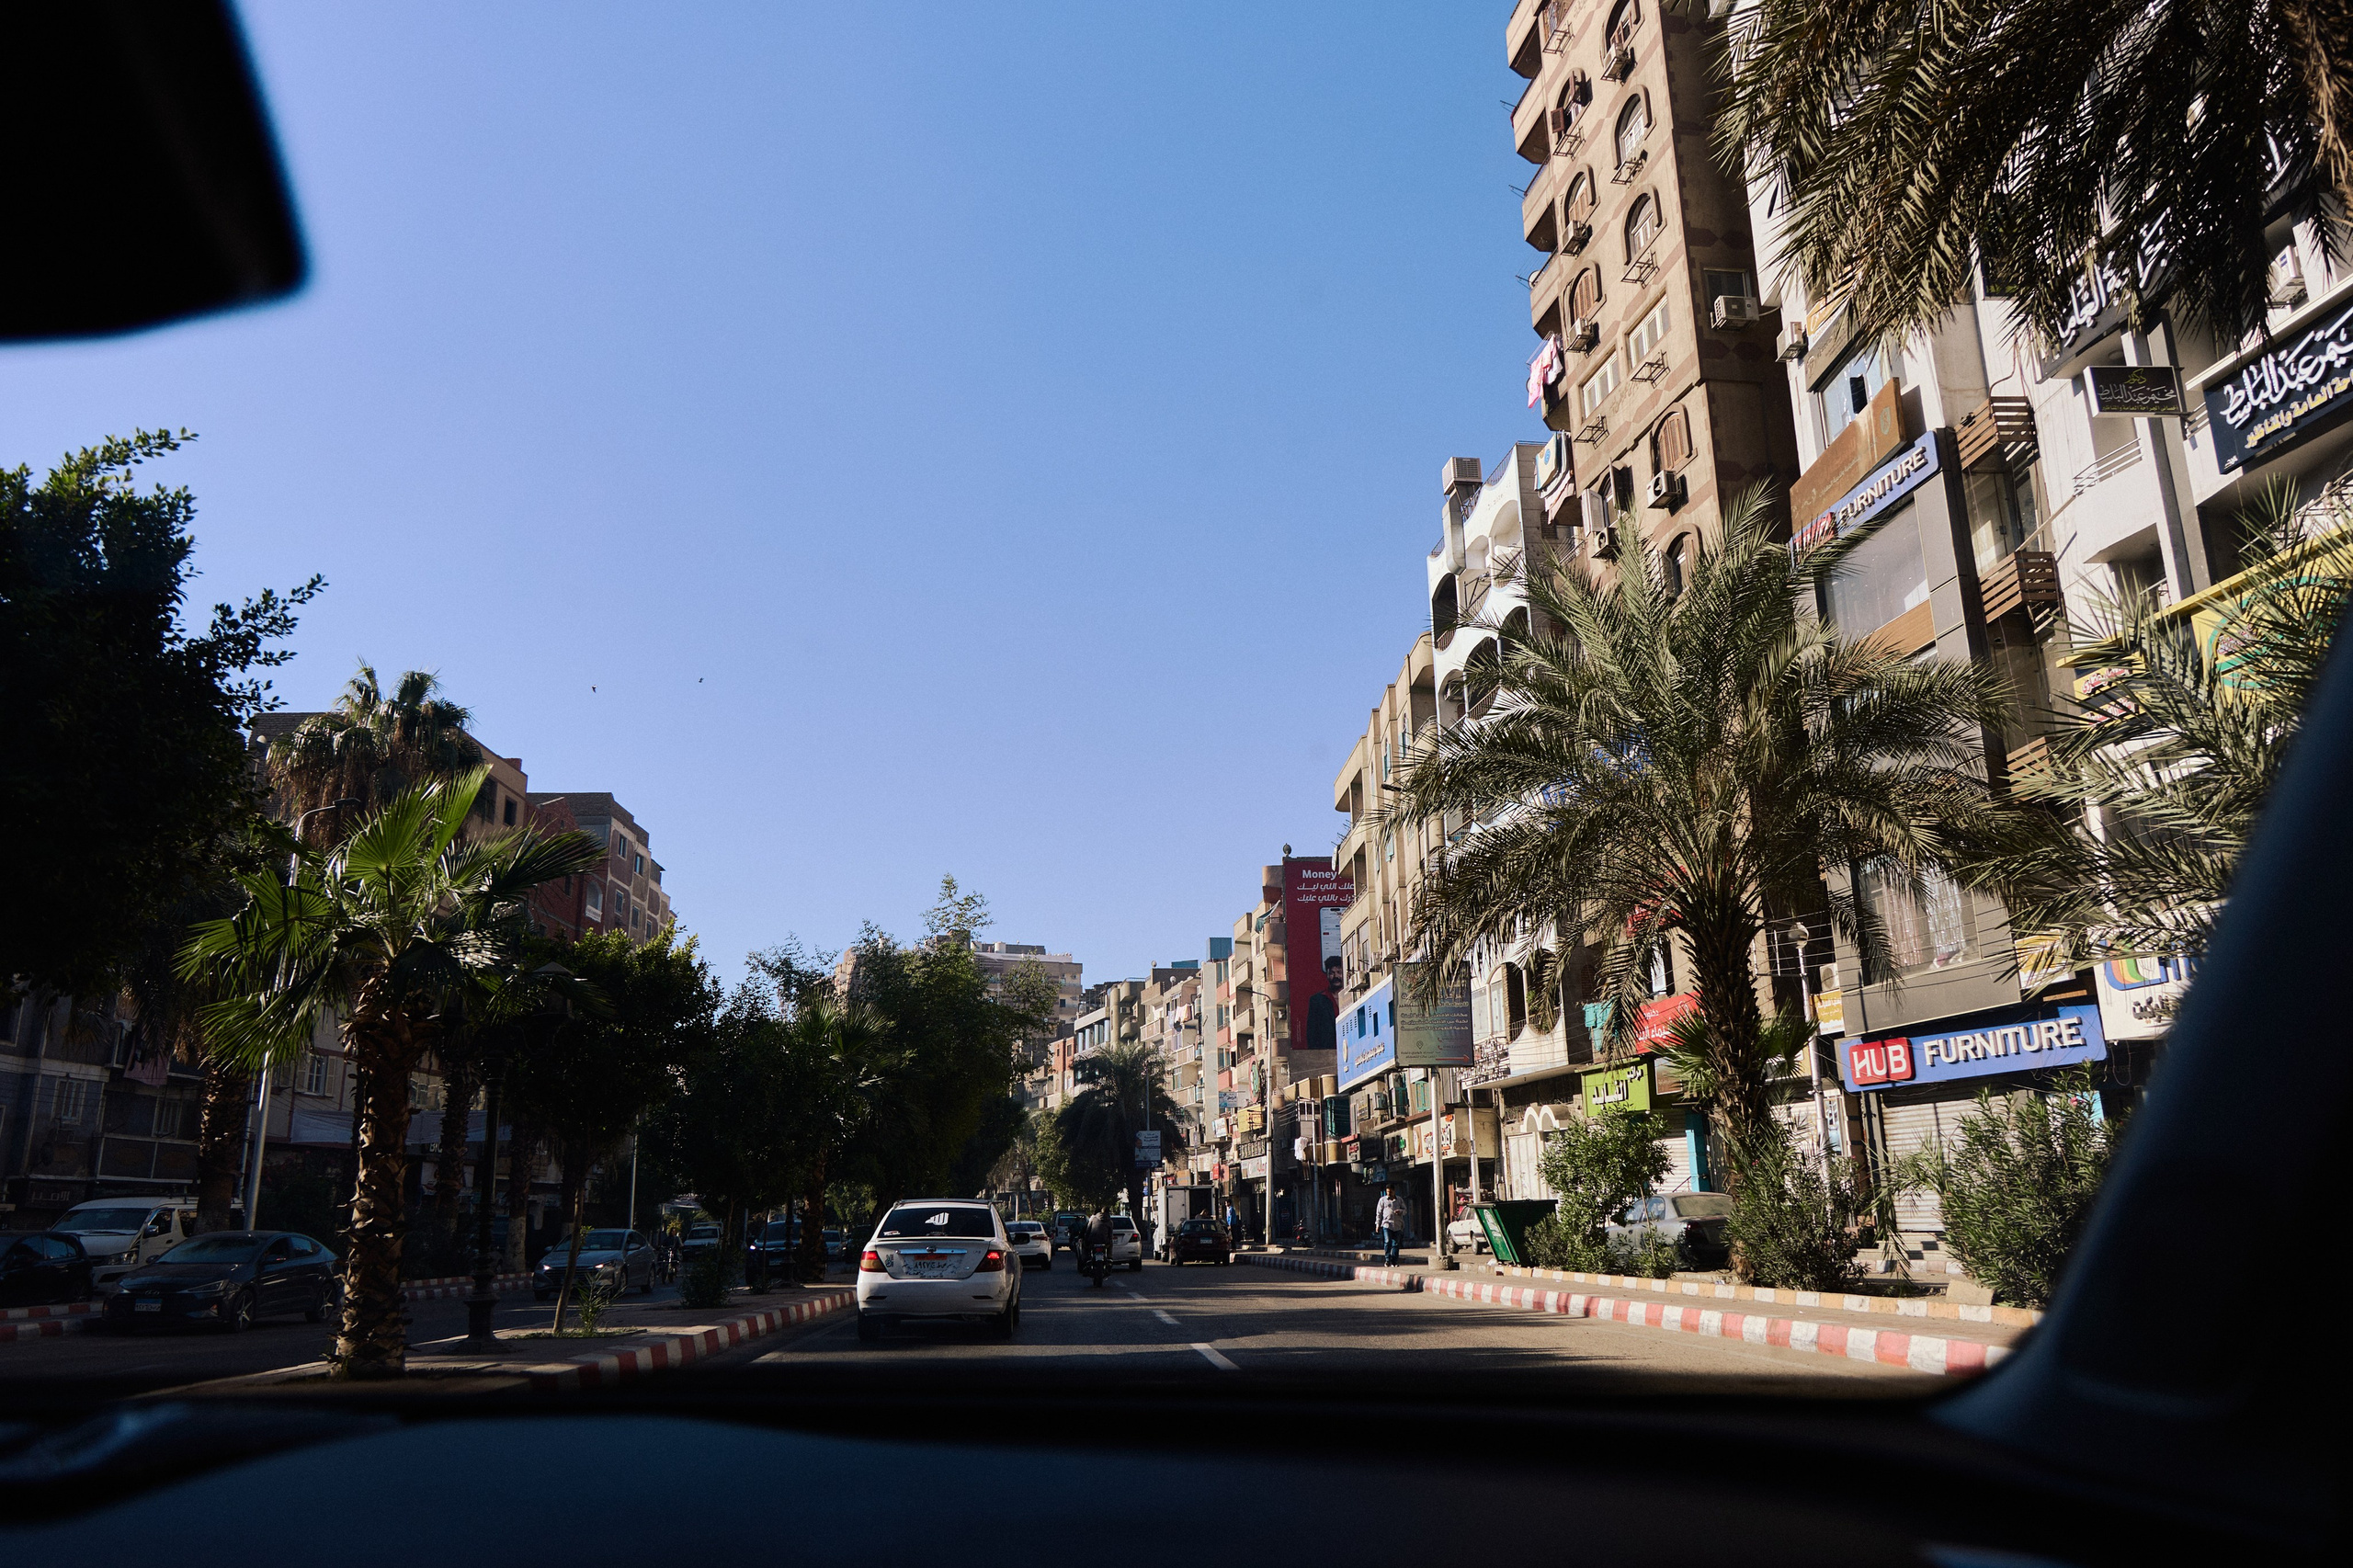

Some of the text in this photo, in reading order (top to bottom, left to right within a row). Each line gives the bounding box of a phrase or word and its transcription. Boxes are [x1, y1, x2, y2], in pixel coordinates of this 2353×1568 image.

[1837, 446, 1927, 525] FURNITURE
[1302, 869, 1337, 881] Money
[1852, 1016, 2086, 1079] HUB FURNITURE
